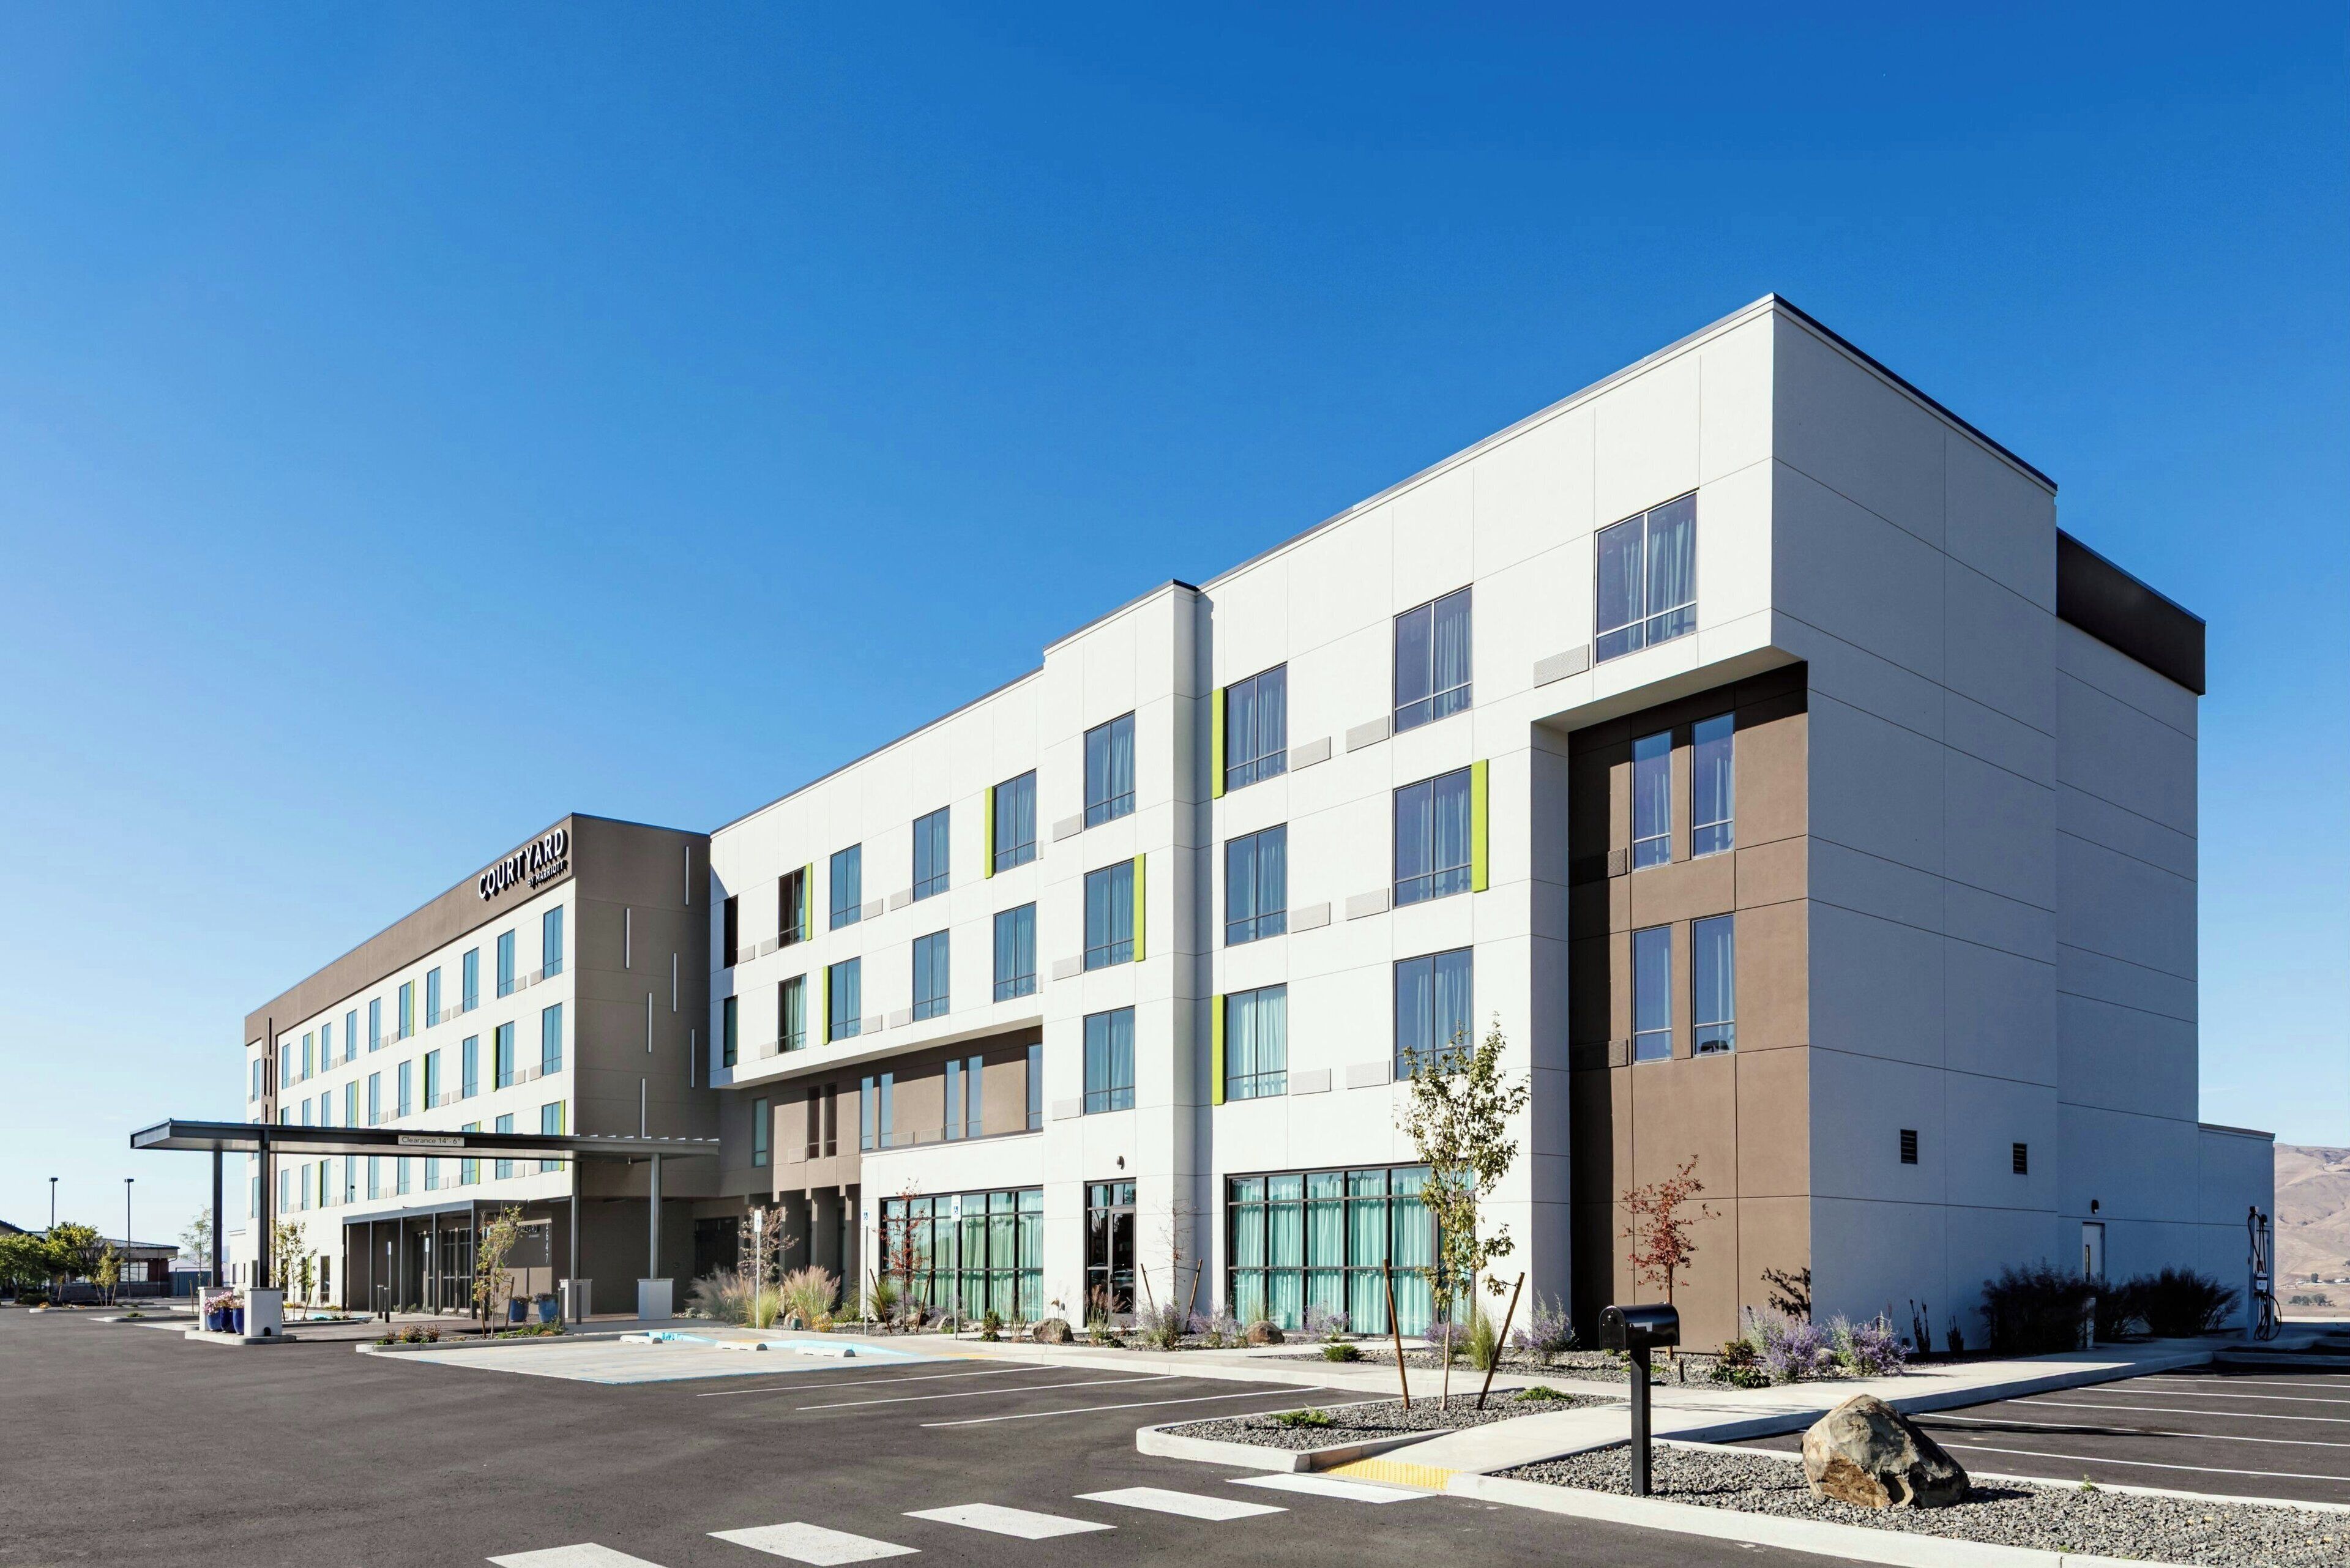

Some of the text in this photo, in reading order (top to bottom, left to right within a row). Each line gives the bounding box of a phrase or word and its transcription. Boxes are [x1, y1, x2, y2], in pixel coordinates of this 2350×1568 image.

[479, 828, 565, 899] COURTYARD
[528, 859, 564, 887] BY MARRIOTT
